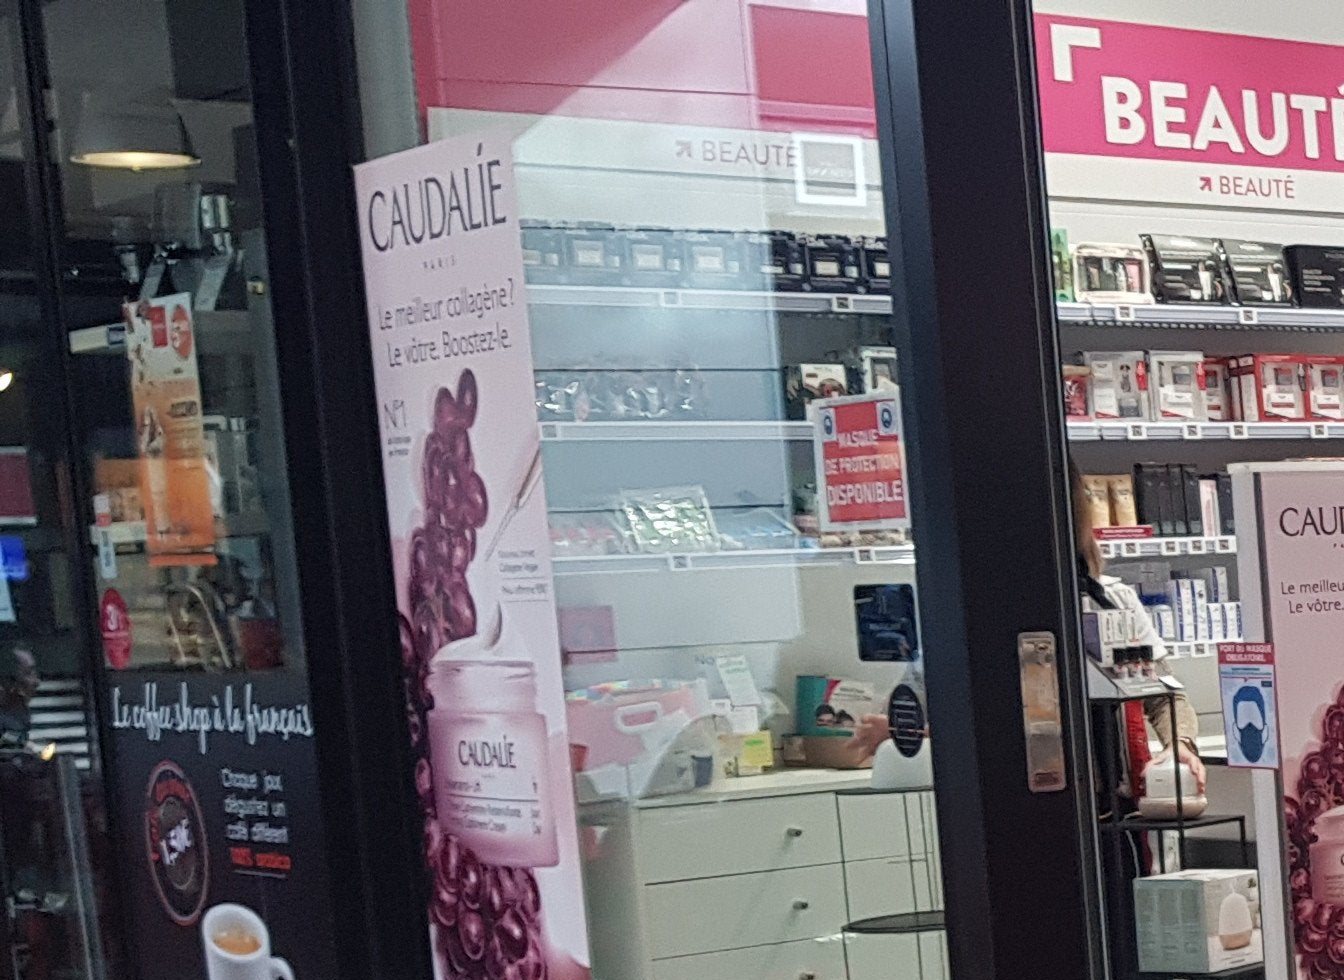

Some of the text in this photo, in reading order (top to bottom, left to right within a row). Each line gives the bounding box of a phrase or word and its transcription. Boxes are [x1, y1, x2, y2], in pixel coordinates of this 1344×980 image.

[369, 142, 506, 250] CAUDALÍE
[1219, 175, 1296, 199] BEAUTÉ
[377, 304, 392, 330] Le
[395, 297, 443, 322] meilleur
[387, 342, 401, 367] Le
[442, 322, 512, 358] Boostez-le.
[836, 429, 879, 448] MASQUE
[824, 453, 900, 476] DE PROTECTION
[826, 479, 903, 506] DISPONIBLE
[1281, 582, 1295, 595] Le
[1289, 600, 1303, 614] Le
[1307, 599, 1344, 613] vôtre.
[174, 681, 211, 755] shop
